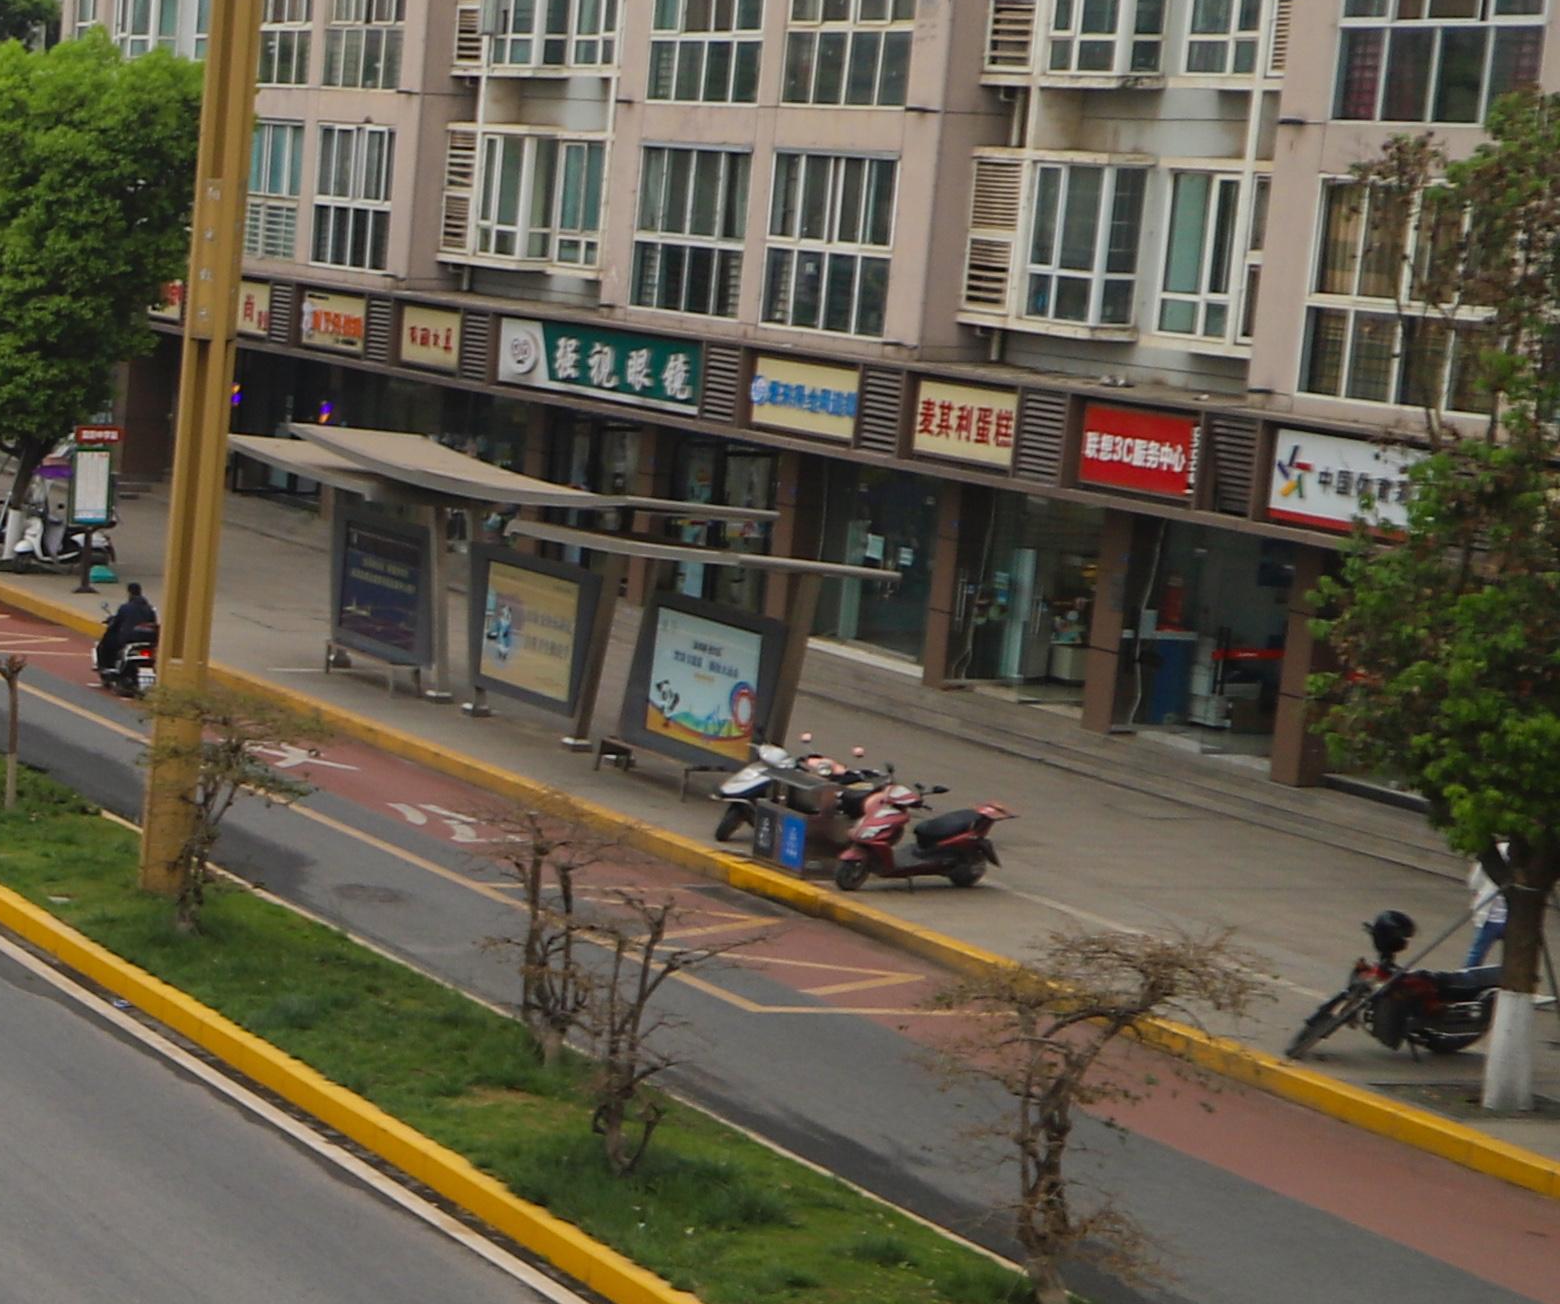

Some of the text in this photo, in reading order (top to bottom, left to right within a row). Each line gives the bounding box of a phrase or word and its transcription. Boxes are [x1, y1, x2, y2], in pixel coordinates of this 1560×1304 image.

[555, 336, 694, 399] 强视眼镜
[918, 398, 1014, 447] 麦其利蛋糕
[1084, 431, 1186, 472] 联想3C服务中心
